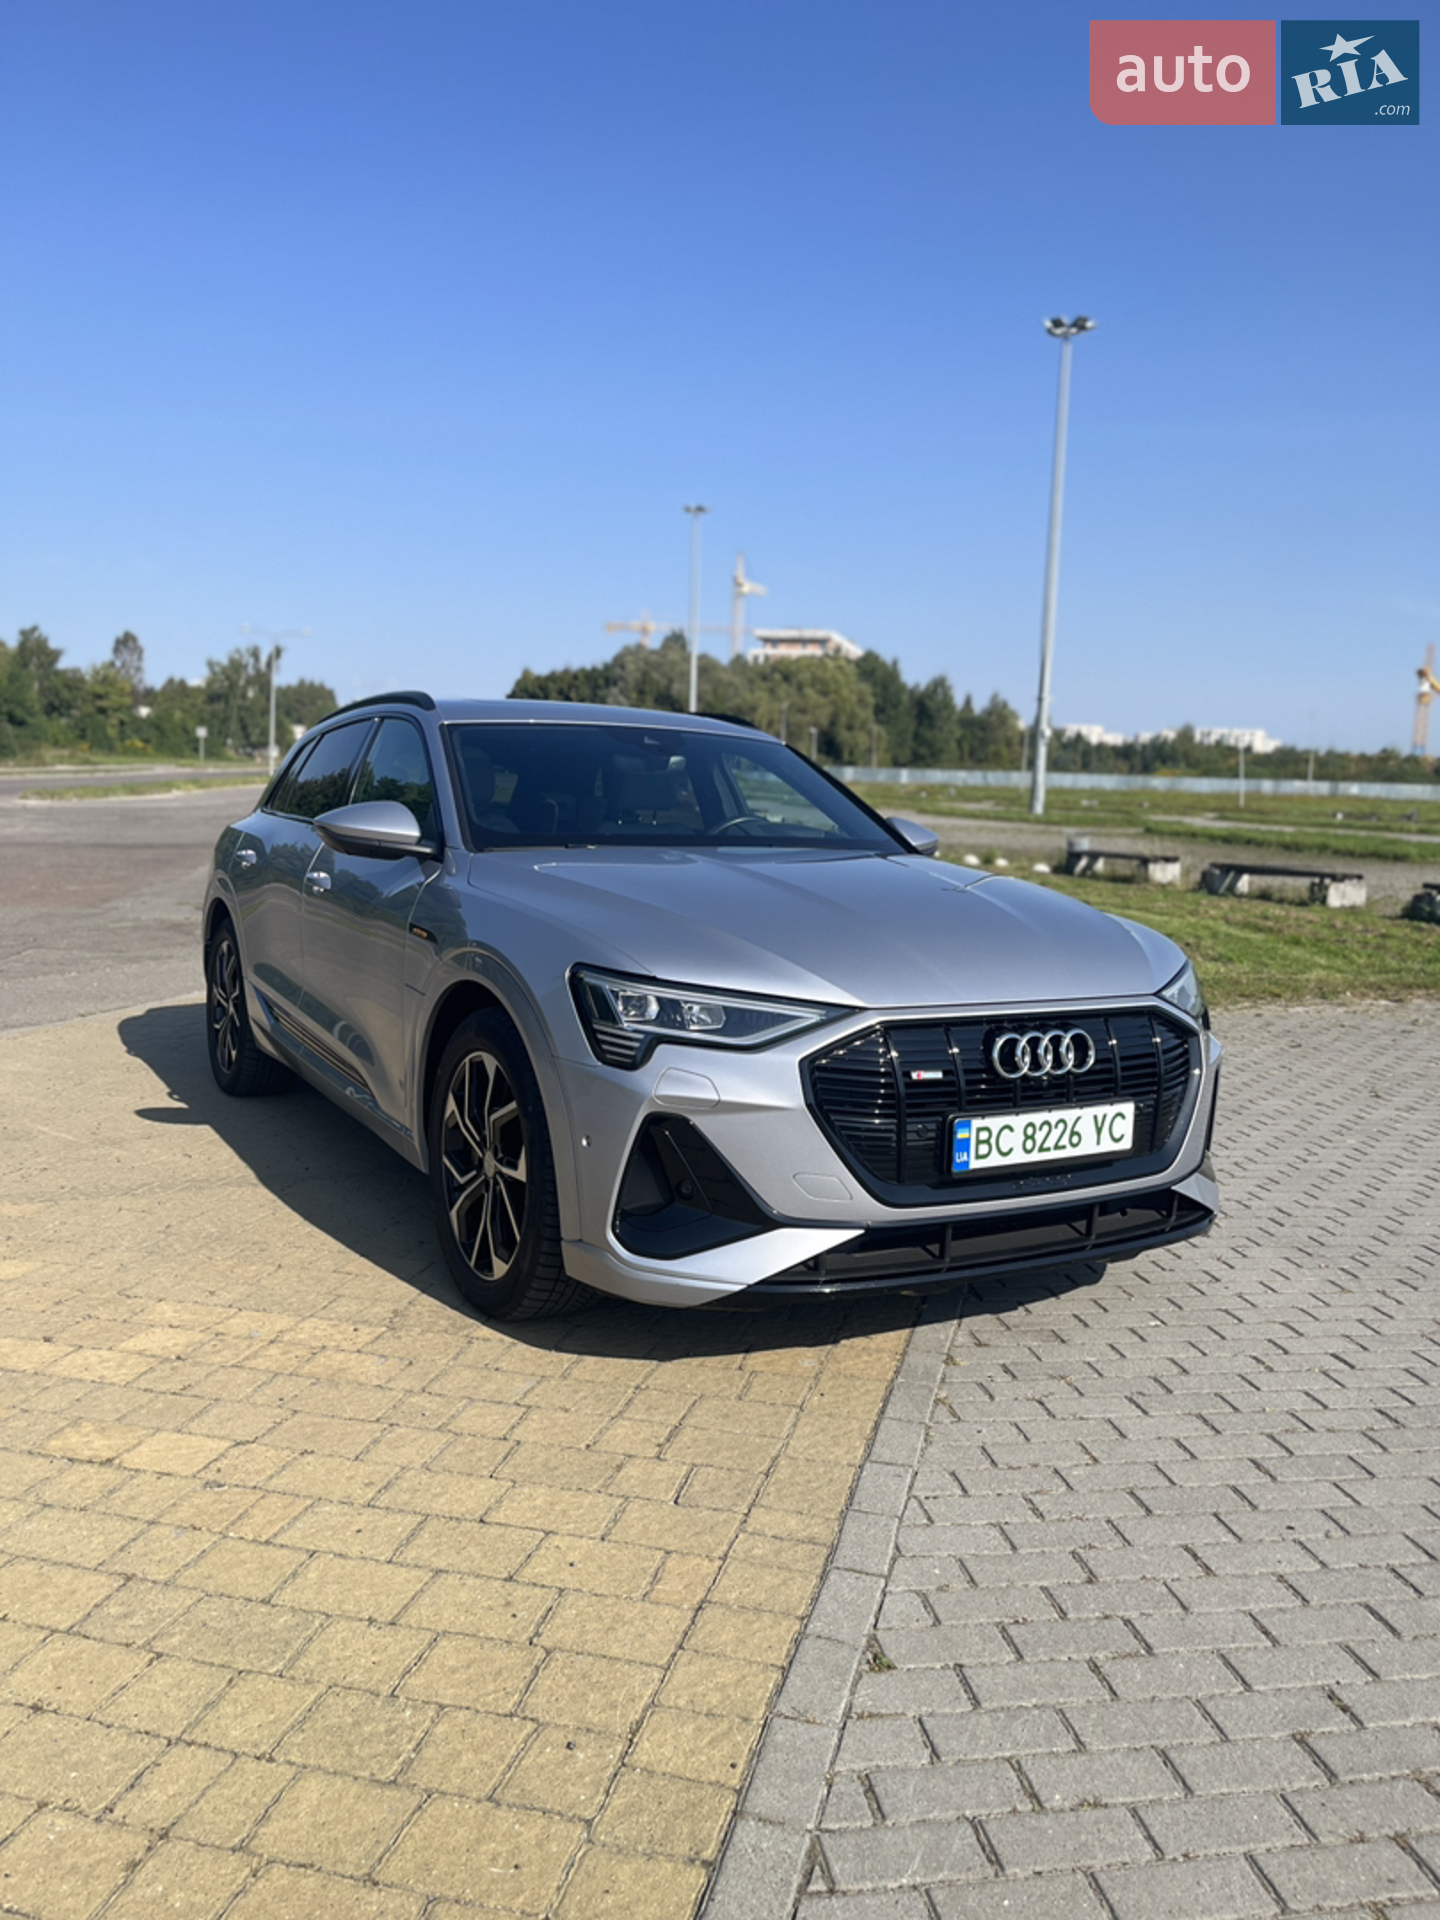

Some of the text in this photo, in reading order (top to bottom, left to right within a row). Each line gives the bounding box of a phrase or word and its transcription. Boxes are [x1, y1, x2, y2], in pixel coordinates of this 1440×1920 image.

[975, 1111, 1126, 1160] BC 8226 YC
[955, 1151, 969, 1163] UA
